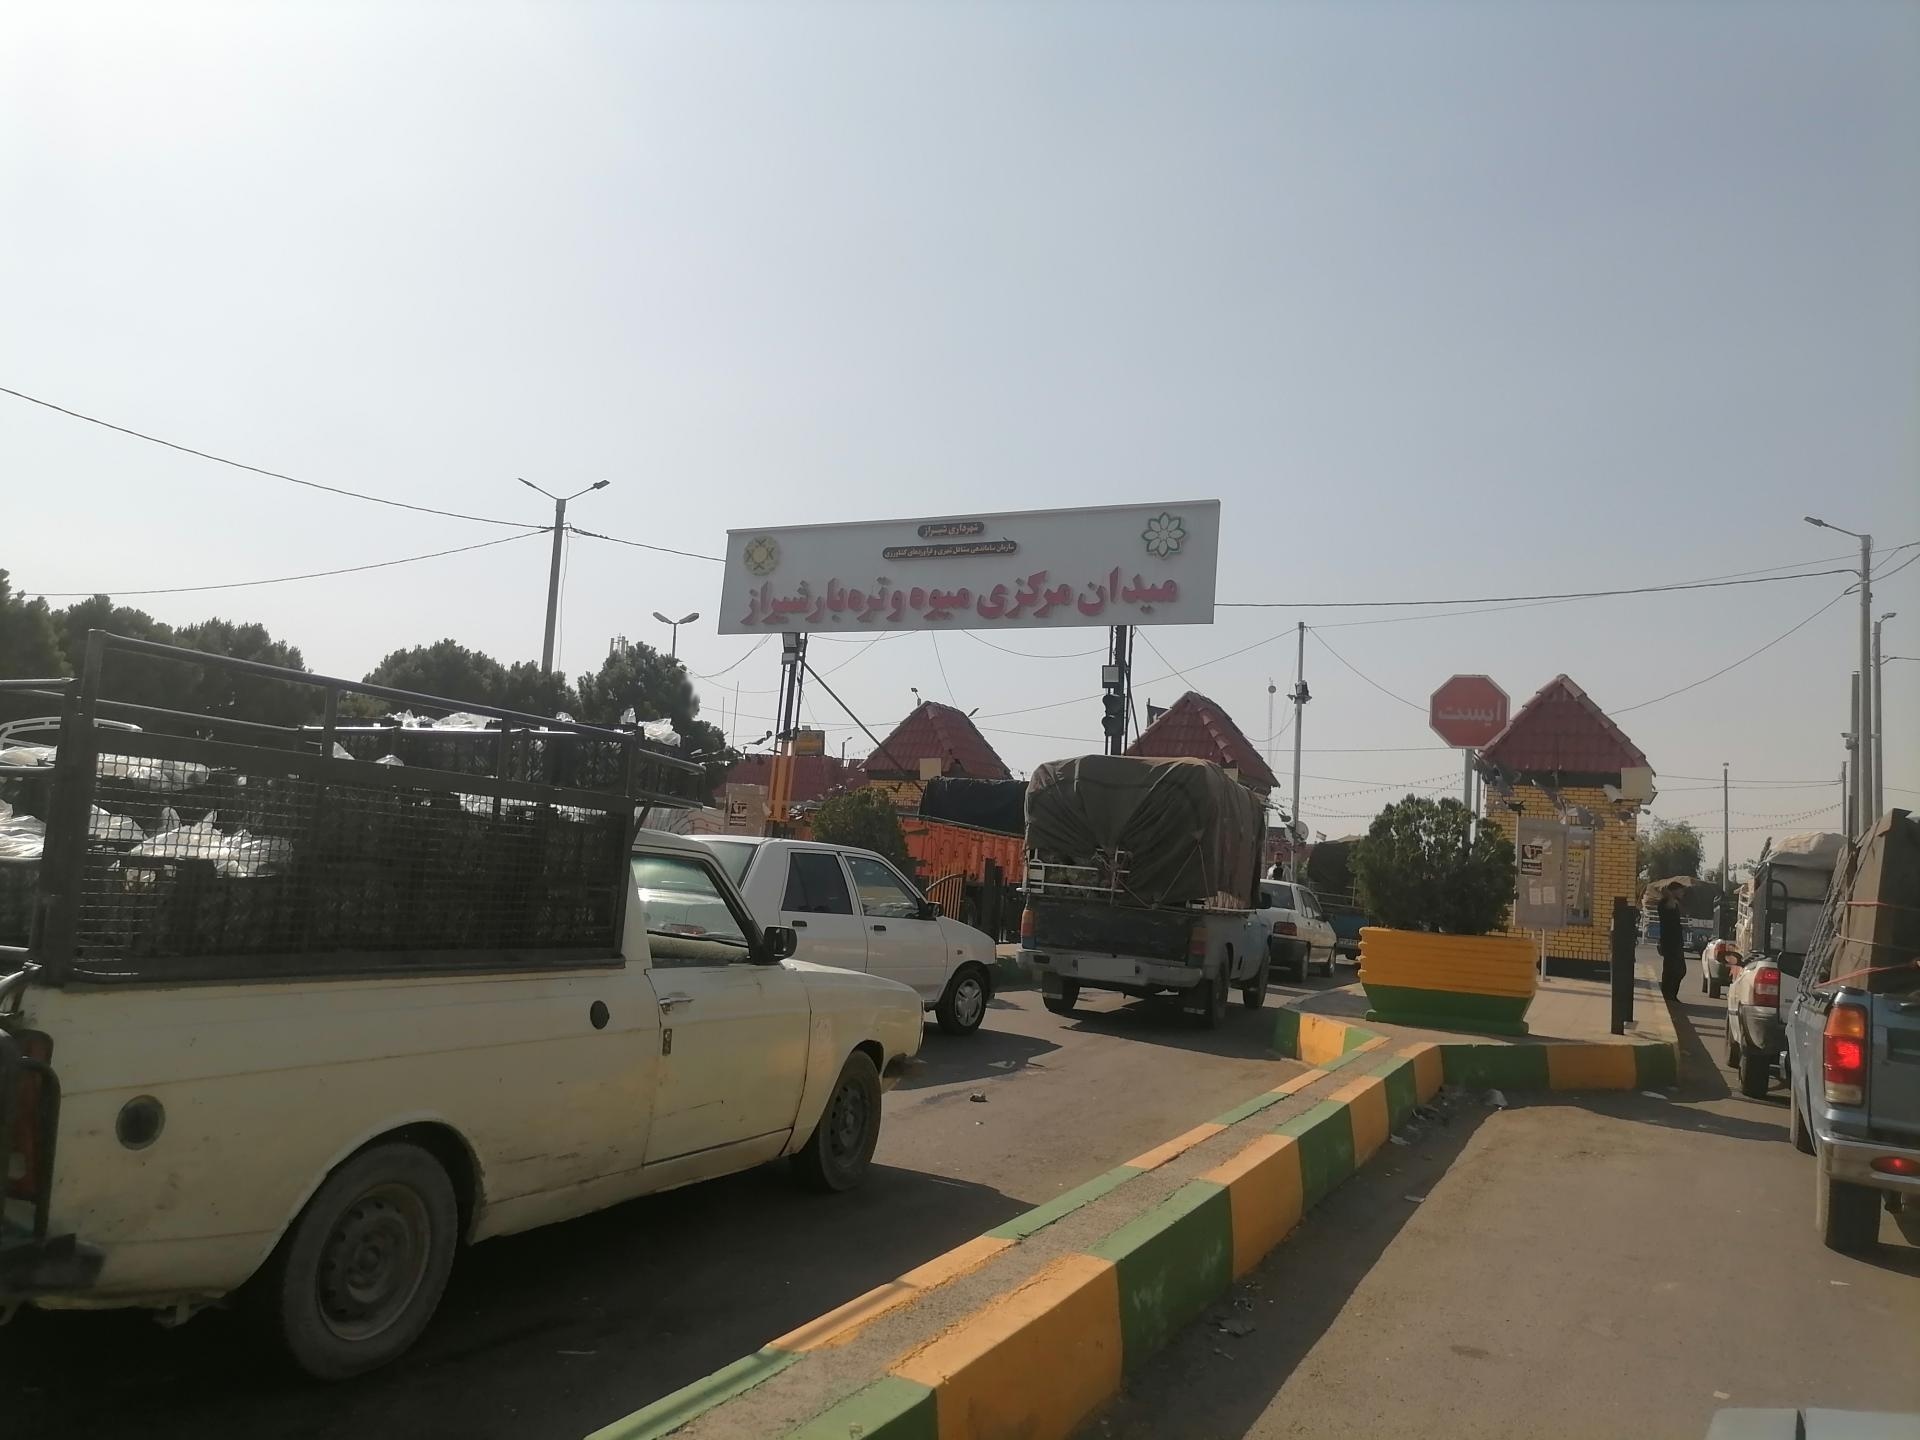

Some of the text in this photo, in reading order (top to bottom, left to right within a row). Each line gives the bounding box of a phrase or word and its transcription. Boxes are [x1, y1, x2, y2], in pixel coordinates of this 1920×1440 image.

[924, 523, 978, 537] شهرداری شیراز
[739, 579, 811, 625] شیراز
[885, 589, 907, 623] و
[909, 586, 971, 623] میوه
[976, 570, 1074, 619] مرکزی
[1077, 566, 1180, 617] میدان
[1438, 698, 1502, 727] ایست
